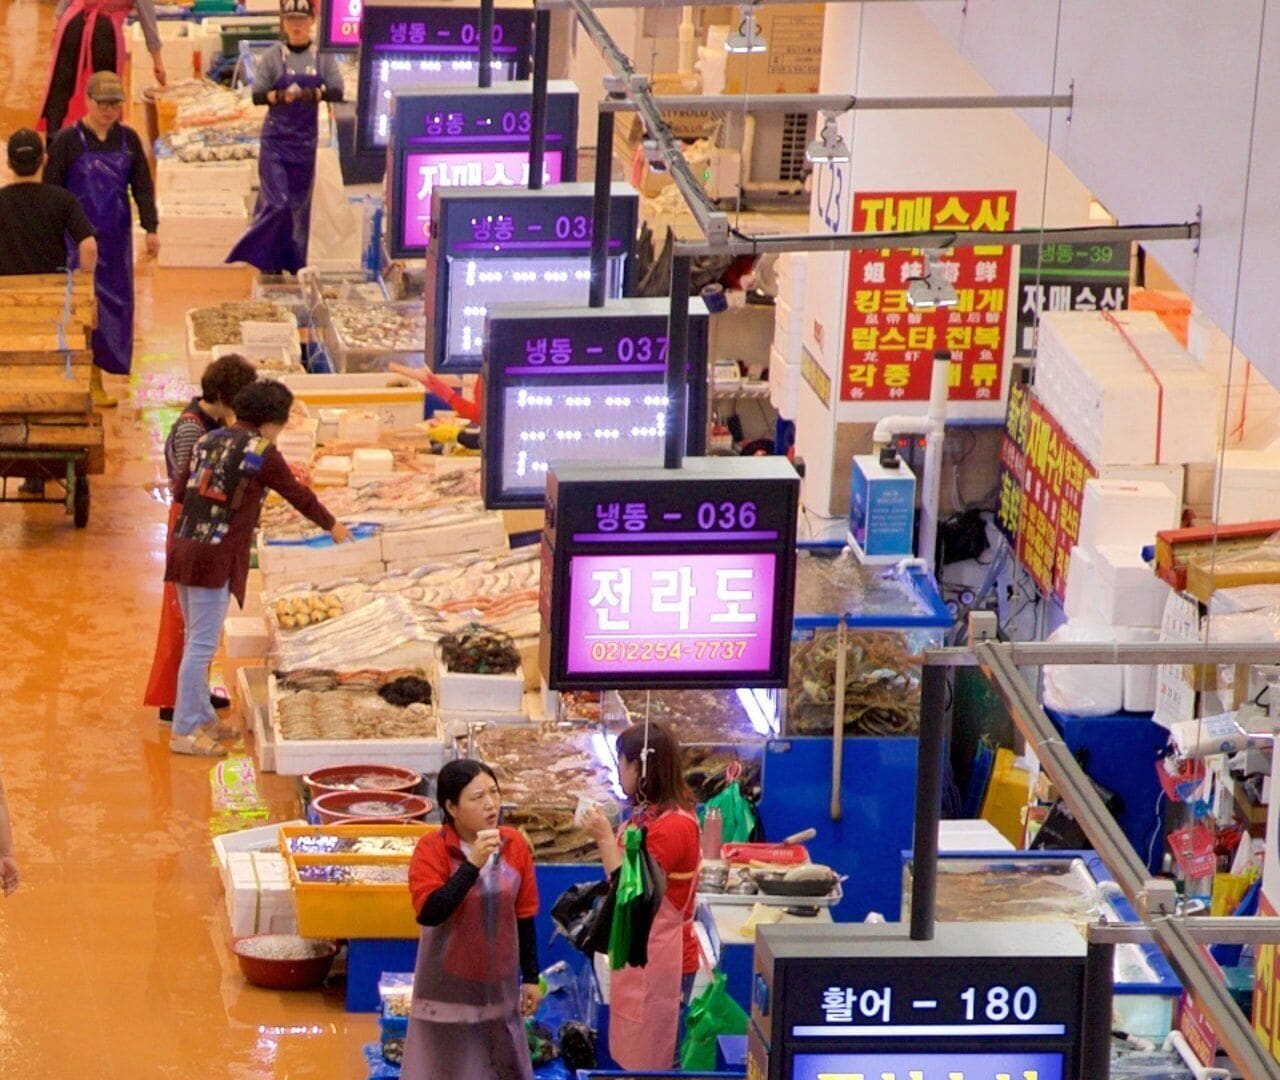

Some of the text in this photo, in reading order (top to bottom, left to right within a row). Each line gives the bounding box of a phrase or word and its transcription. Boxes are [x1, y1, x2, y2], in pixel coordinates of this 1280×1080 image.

[390, 22, 426, 44] 냉동
[461, 24, 503, 44] 00
[425, 112, 464, 134] 냉동
[502, 112, 531, 133] 03
[473, 216, 514, 241] 냉동
[556, 215, 593, 239] 03
[855, 289, 936, 313] 킹크
[851, 326, 1000, 350] 랍스타 전복
[526, 338, 573, 365] 냉동
[617, 337, 669, 362] 037
[596, 502, 648, 531] 냉동
[697, 501, 757, 530] 036
[588, 565, 757, 631] 전라도
[591, 641, 748, 663] 02)2254-7737
[821, 986, 892, 1023] 활어
[959, 985, 1037, 1021] 180
